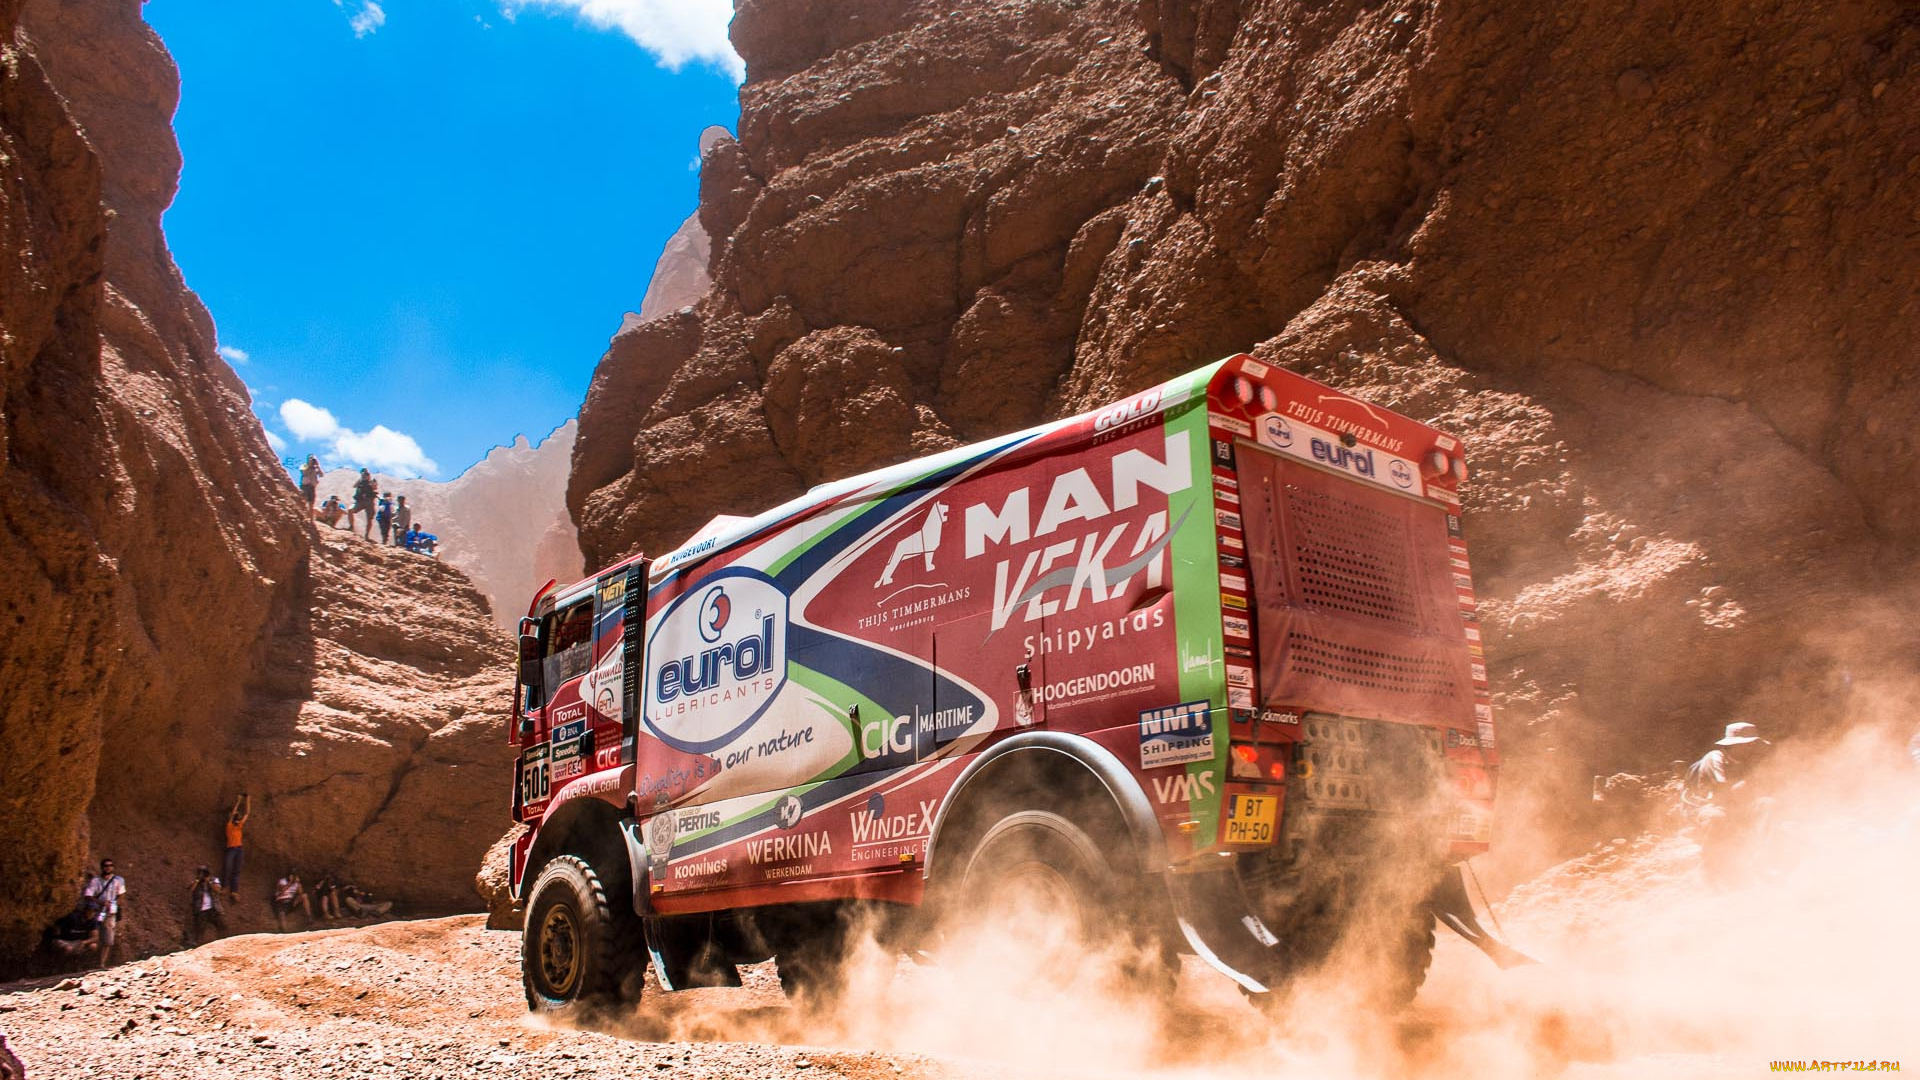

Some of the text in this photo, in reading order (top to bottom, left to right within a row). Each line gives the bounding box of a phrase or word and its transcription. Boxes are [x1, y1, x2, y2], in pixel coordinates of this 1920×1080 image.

[1094, 391, 1161, 432] GOLD
[1287, 401, 1404, 452] THIJS TIMMERMANS
[1093, 431, 1116, 445] DISC
[1122, 416, 1156, 434] BRAKE
[1311, 437, 1376, 478] eurol
[965, 429, 1192, 560] MAN
[991, 510, 1168, 632] VEKA
[858, 586, 971, 630] THIJS TIMMERMANS
[1024, 608, 1164, 660] Shipyards
[657, 613, 776, 704] eurol
[655, 678, 773, 721] LUBRICANTS
[1033, 662, 1156, 704] HOOGENDOORN
[556, 707, 583, 722] TOTAL
[1141, 702, 1209, 736] NMT
[1251, 707, 1299, 725] Dckmarks
[862, 705, 974, 759] CIG MARITIME
[1143, 736, 1211, 756] SHIPPING
[555, 743, 579, 759] SpeedAg
[596, 747, 618, 769] CIG
[640, 726, 814, 797] Quality is in our nature
[523, 762, 550, 802] 506
[558, 778, 621, 802] TrucksXL.com
[1152, 770, 1215, 804] VMS
[526, 804, 545, 816] TOTAL
[678, 811, 721, 833] PERTIJS
[1245, 799, 1264, 816] BT
[746, 831, 832, 865] WERKINA
[1230, 821, 1270, 841] PH-50
[675, 857, 728, 879] KOONINGS
[851, 844, 918, 862] ENGINEERING
[765, 865, 813, 880] WERKENDAM
